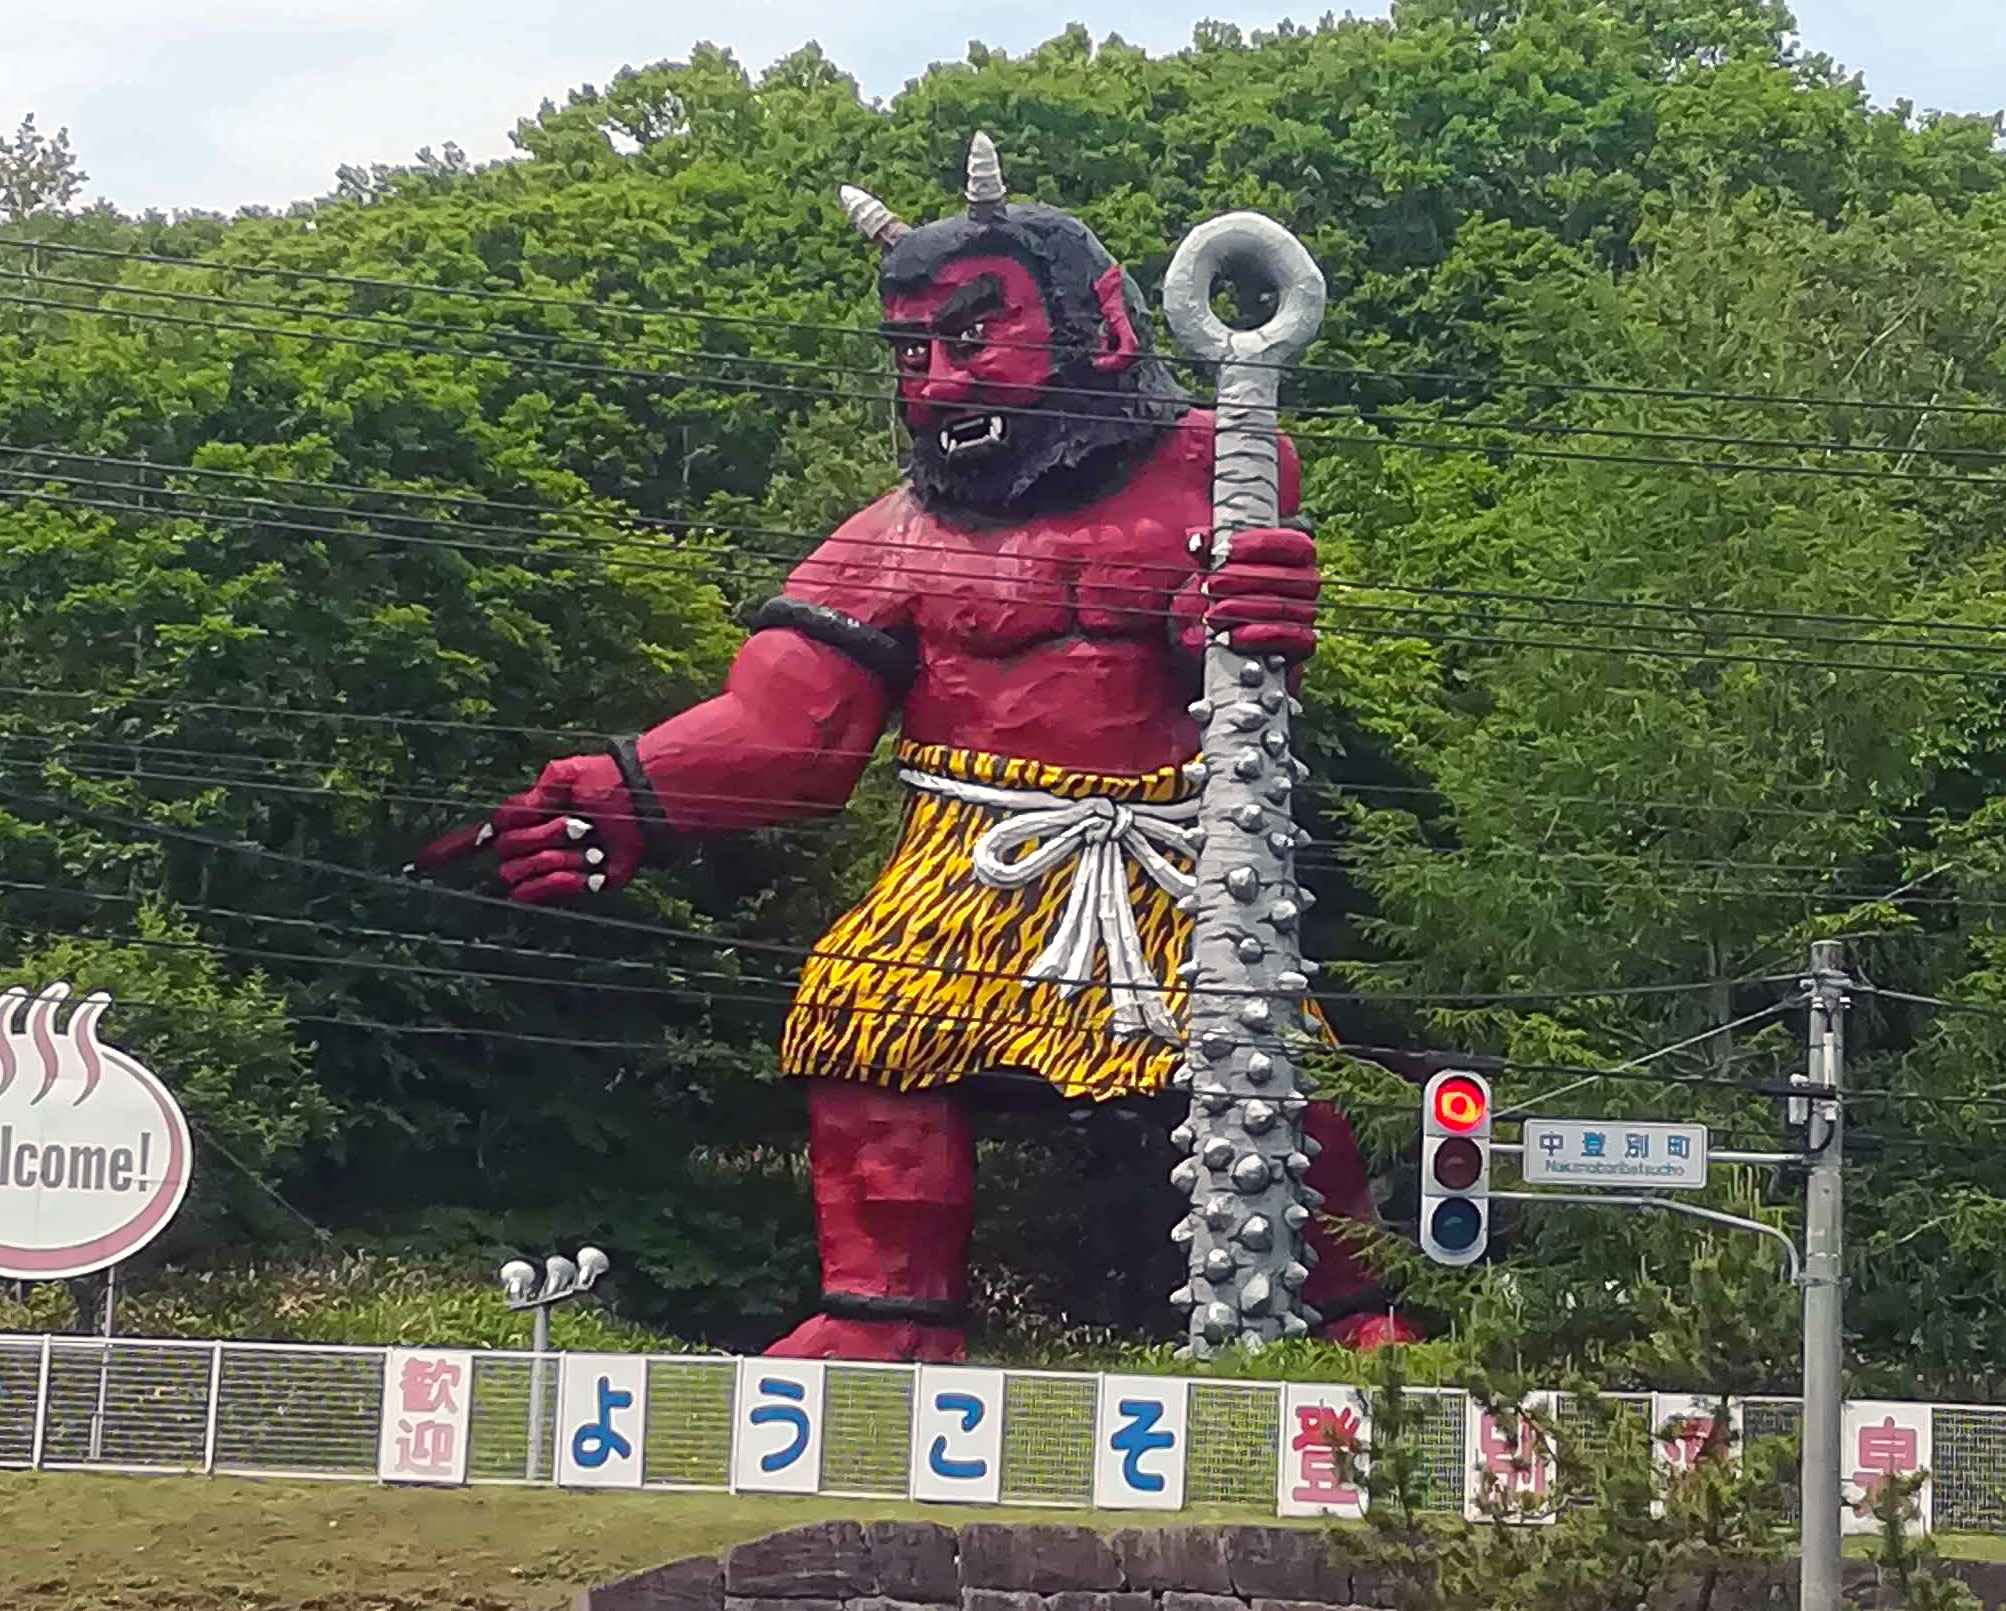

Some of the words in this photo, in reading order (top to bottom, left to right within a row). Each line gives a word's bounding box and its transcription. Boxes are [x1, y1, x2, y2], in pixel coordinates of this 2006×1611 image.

[1539, 1131, 1691, 1160] 中登別町
[395, 1357, 461, 1476] 歓迎
